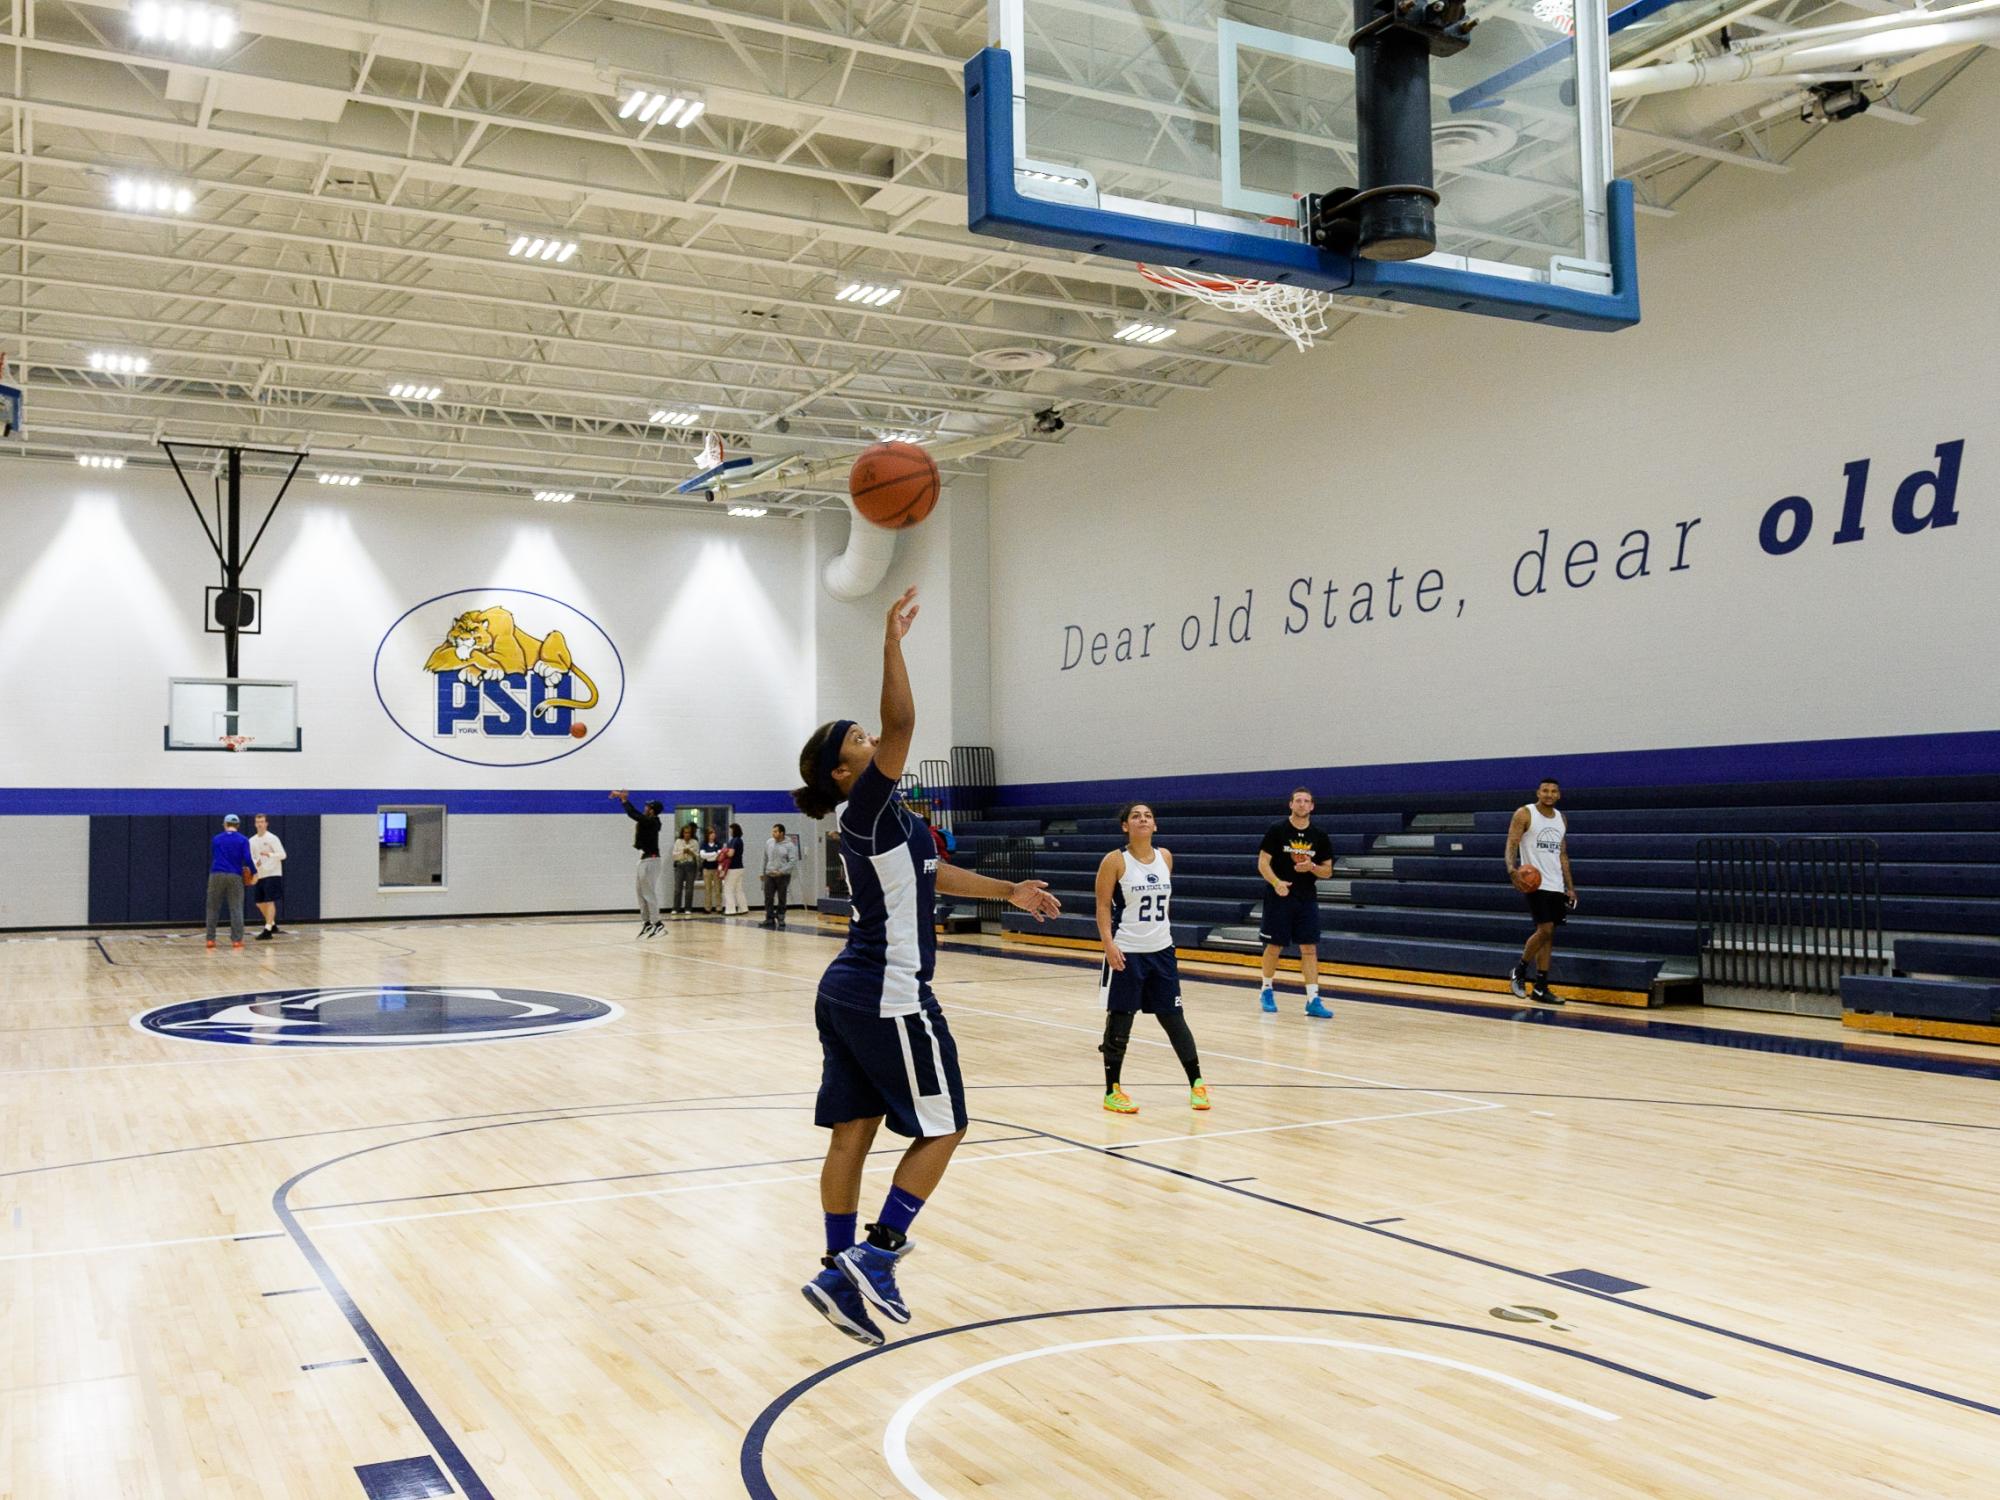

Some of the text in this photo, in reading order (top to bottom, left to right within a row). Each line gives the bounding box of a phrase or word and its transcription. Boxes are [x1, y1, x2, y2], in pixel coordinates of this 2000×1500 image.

[1061, 439, 1965, 671] Dear old State, dear old
[435, 671, 574, 738] PSU
[1139, 895, 1166, 921] 25
